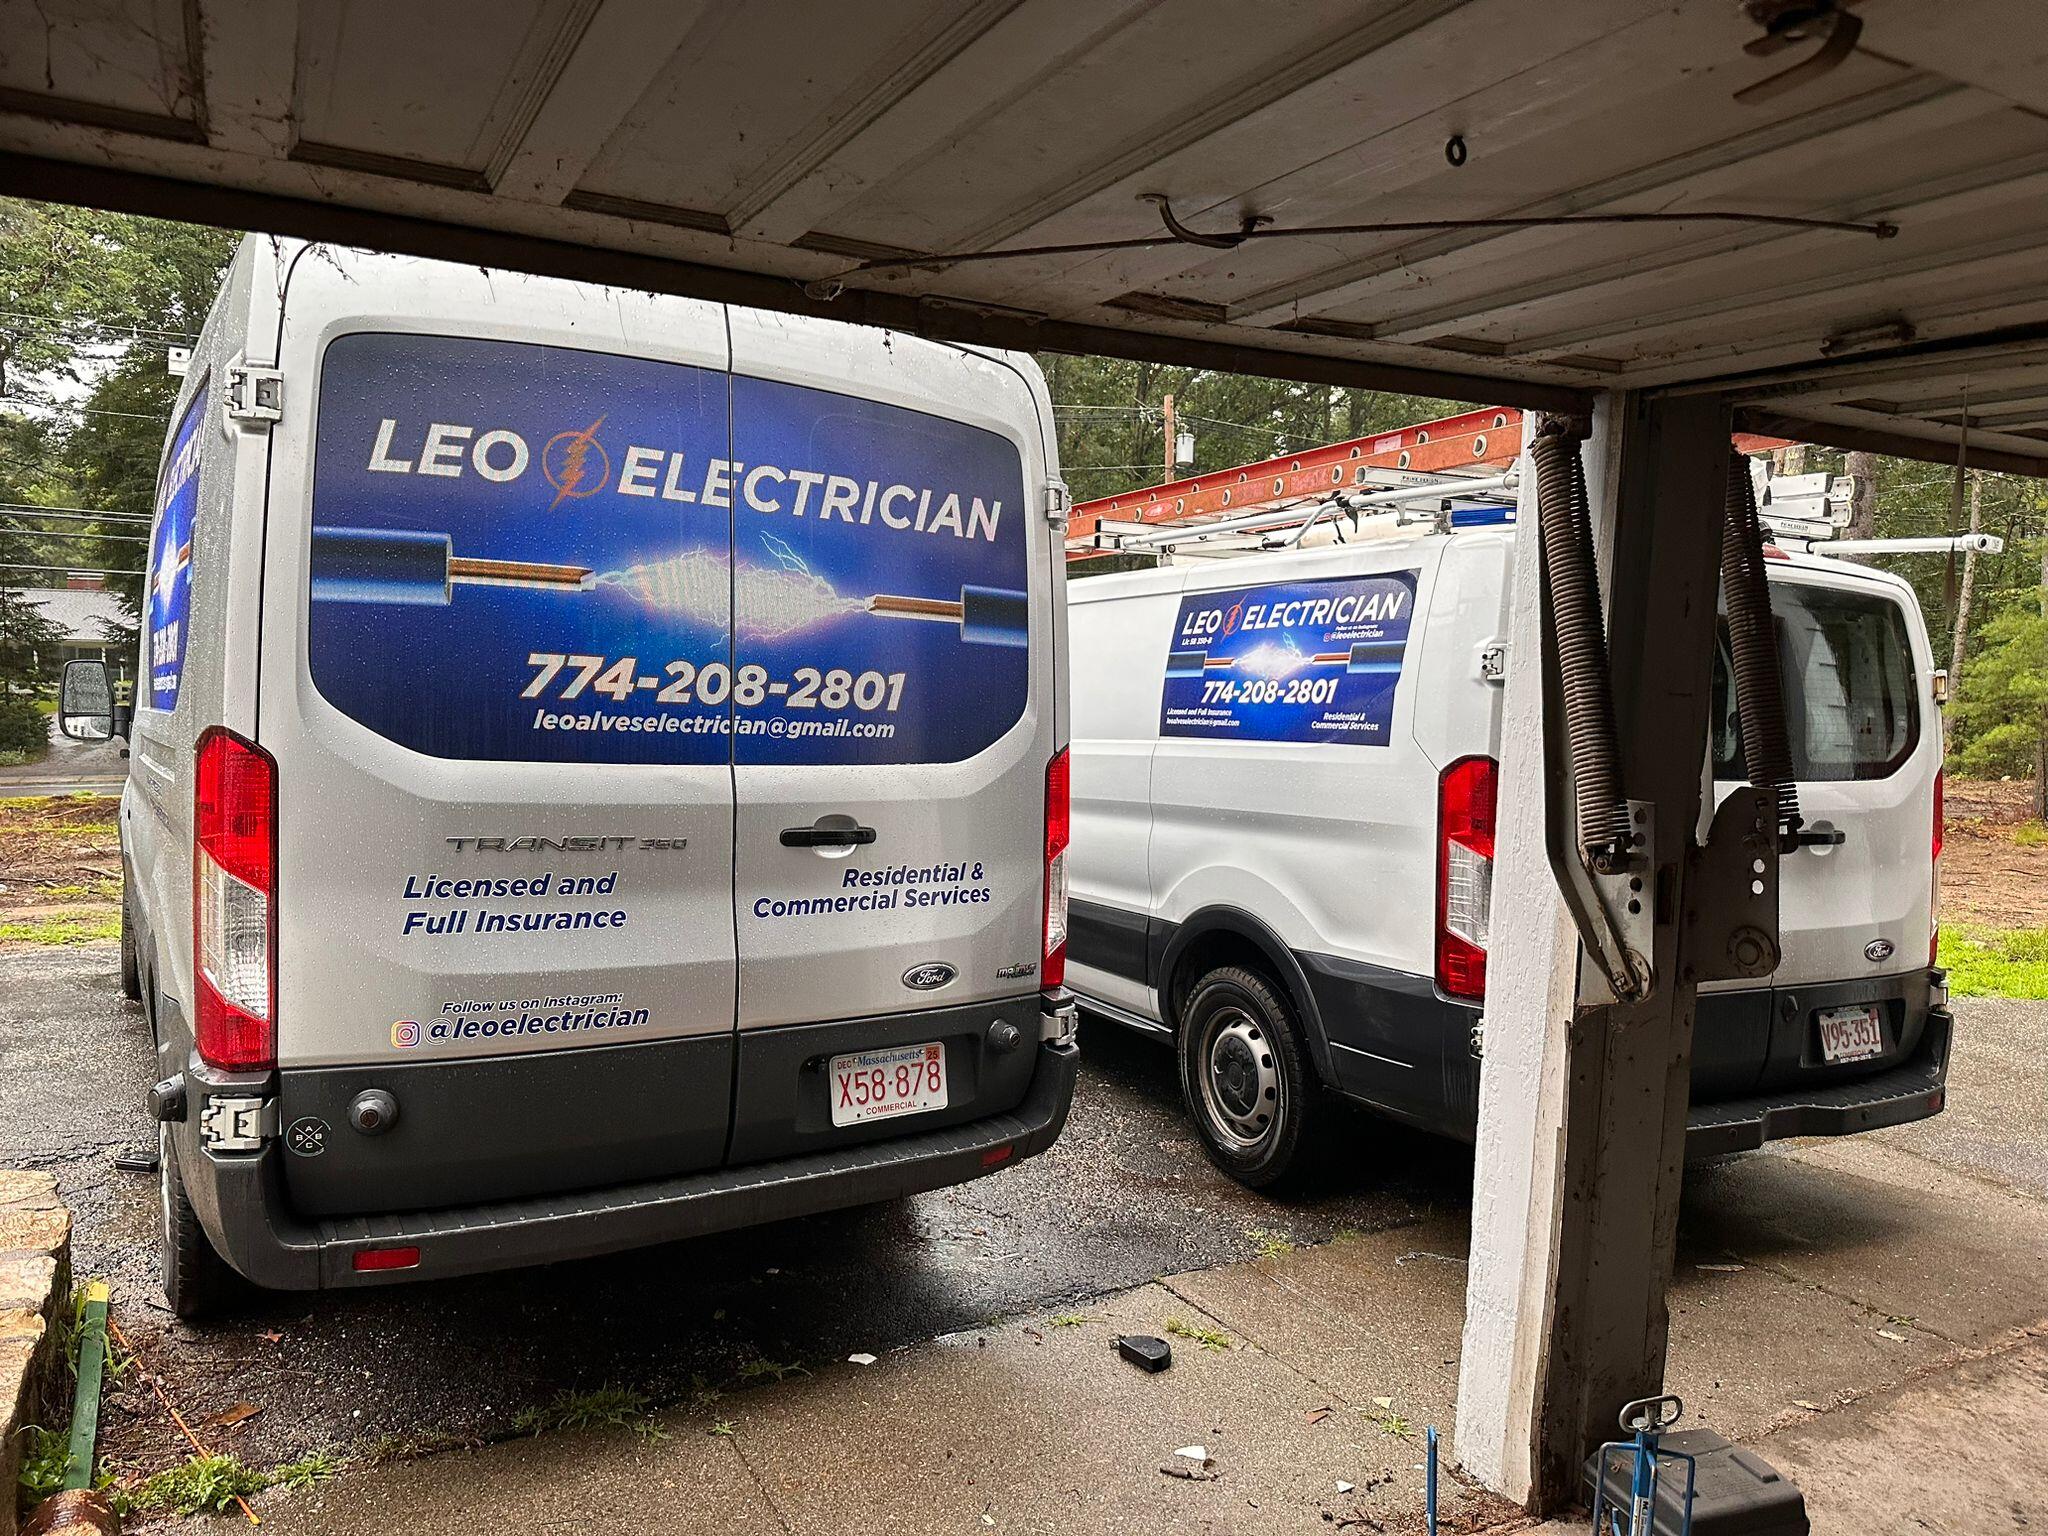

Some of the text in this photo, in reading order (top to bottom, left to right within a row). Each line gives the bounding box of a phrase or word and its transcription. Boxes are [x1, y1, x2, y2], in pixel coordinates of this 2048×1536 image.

[368, 419, 1001, 541] LEO ELECTRICIAN
[1181, 592, 1405, 635] LEO ELECTRICIAN
[520, 653, 907, 712] 774-208-2801
[1200, 678, 1339, 704] 774-208-2801
[533, 709, 895, 740] leoalveselectrician@gmail.com
[1198, 708, 1208, 716] Full
[1208, 709, 1233, 717] Insurance
[1311, 720, 1380, 731] Commercial Services
[1323, 712, 1360, 721] Residential
[446, 836, 688, 852] TRANSIT 350
[402, 871, 618, 900] Licensed and
[841, 861, 985, 888] Residential &
[753, 886, 990, 918] Commercial Services
[402, 909, 627, 936] Full Insurance
[917, 968, 946, 985] Ford
[441, 993, 624, 1014] Follow us on Instagram:
[424, 1006, 650, 1046] @leoelectrician
[837, 1059, 852, 1070] DEC
[857, 1049, 920, 1067] Massachusetts
[866, 1101, 917, 1115] COMMERCIAL
